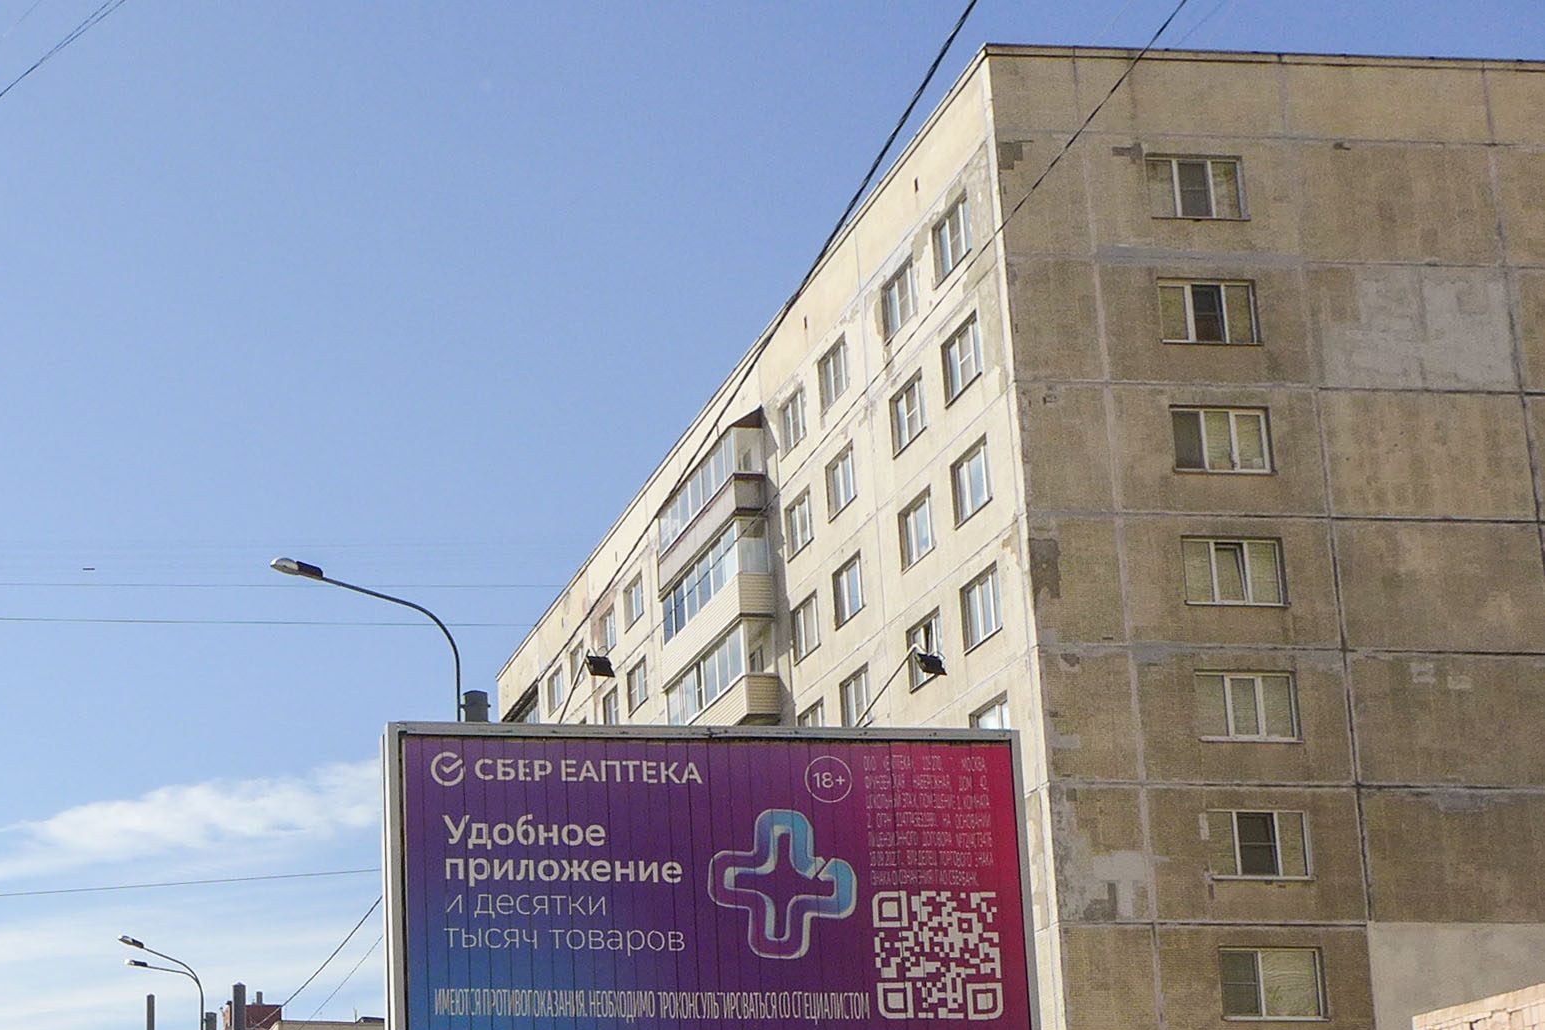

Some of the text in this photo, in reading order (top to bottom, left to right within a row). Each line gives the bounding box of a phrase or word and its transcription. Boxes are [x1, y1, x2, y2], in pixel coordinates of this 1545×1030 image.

[474, 758, 703, 784] СБЕР ЕАПТЕКА
[813, 772, 845, 789] 18+
[442, 814, 606, 850] Удобное
[445, 858, 684, 888] приложение
[474, 893, 607, 919] десятки
[444, 928, 686, 957] тысяч товаров
[434, 988, 481, 1016] ИМЕЮТСЯ
[589, 990, 655, 1024] НЕОБХОДИМО
[778, 991, 791, 1019] СО
